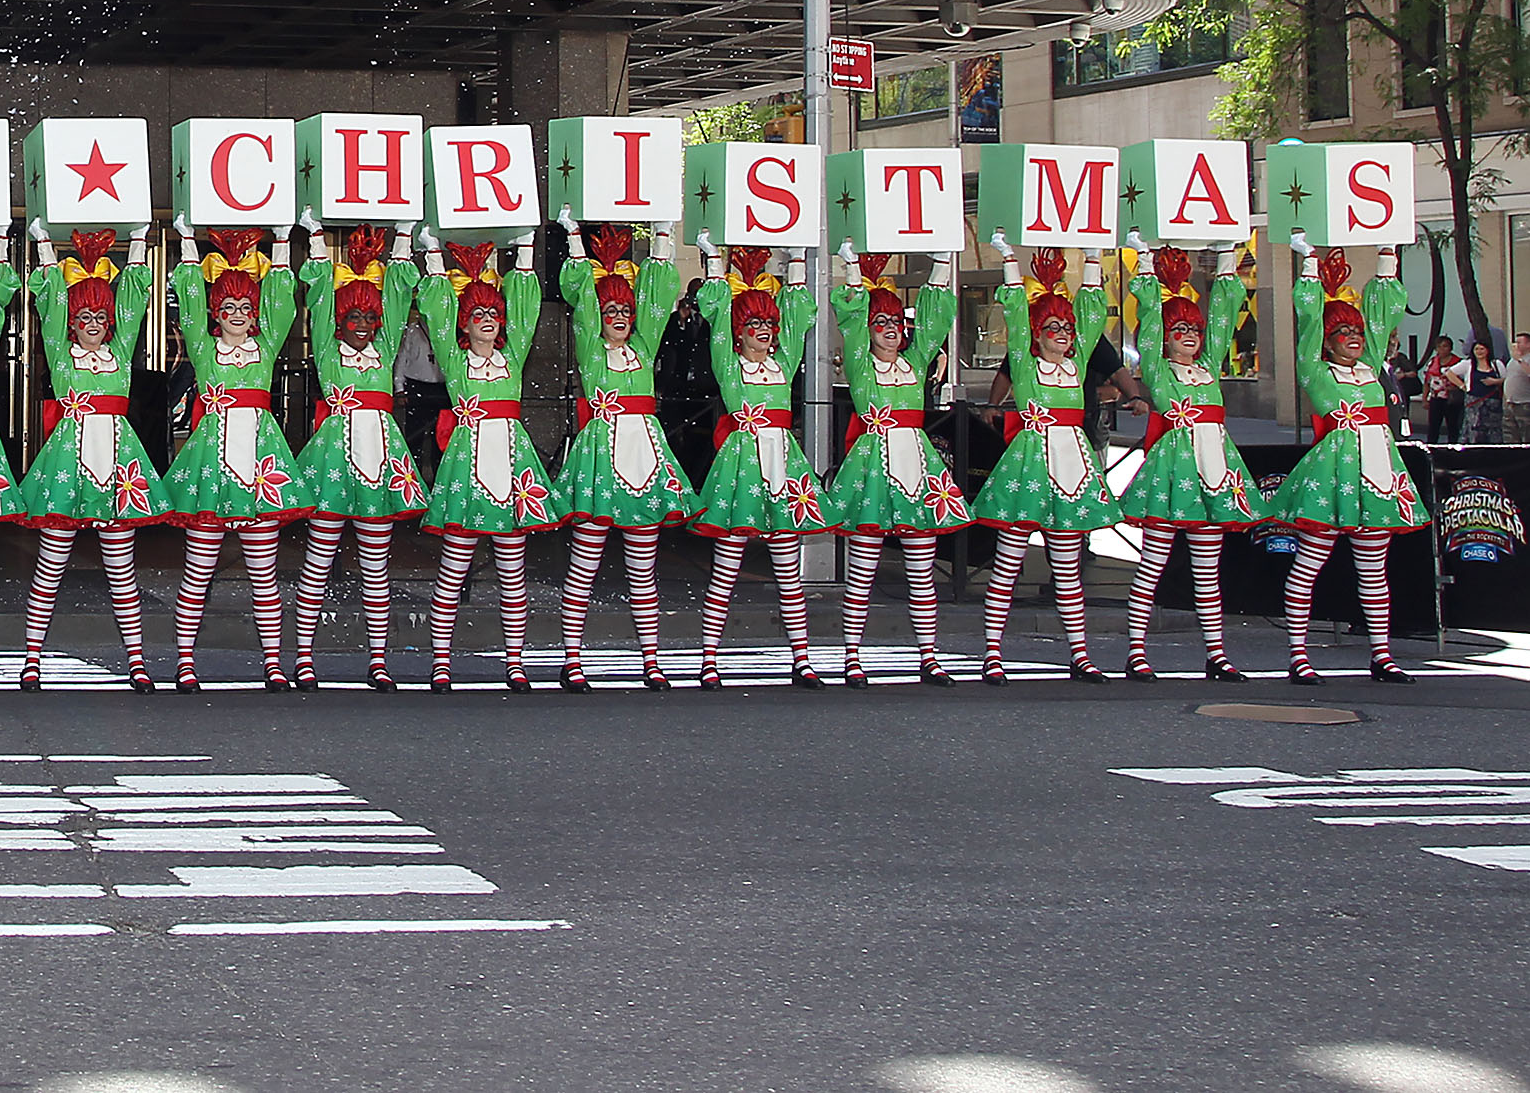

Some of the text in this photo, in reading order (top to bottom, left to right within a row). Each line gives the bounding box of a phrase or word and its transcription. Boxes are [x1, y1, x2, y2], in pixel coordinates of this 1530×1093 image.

[832, 44, 840, 53] NO
[211, 128, 1392, 234] CHRISTMAS
[1456, 479, 1499, 491] RADIO CITY
[1443, 492, 1514, 516] CHRISTMAS
[1463, 549, 1487, 558] CHASE
